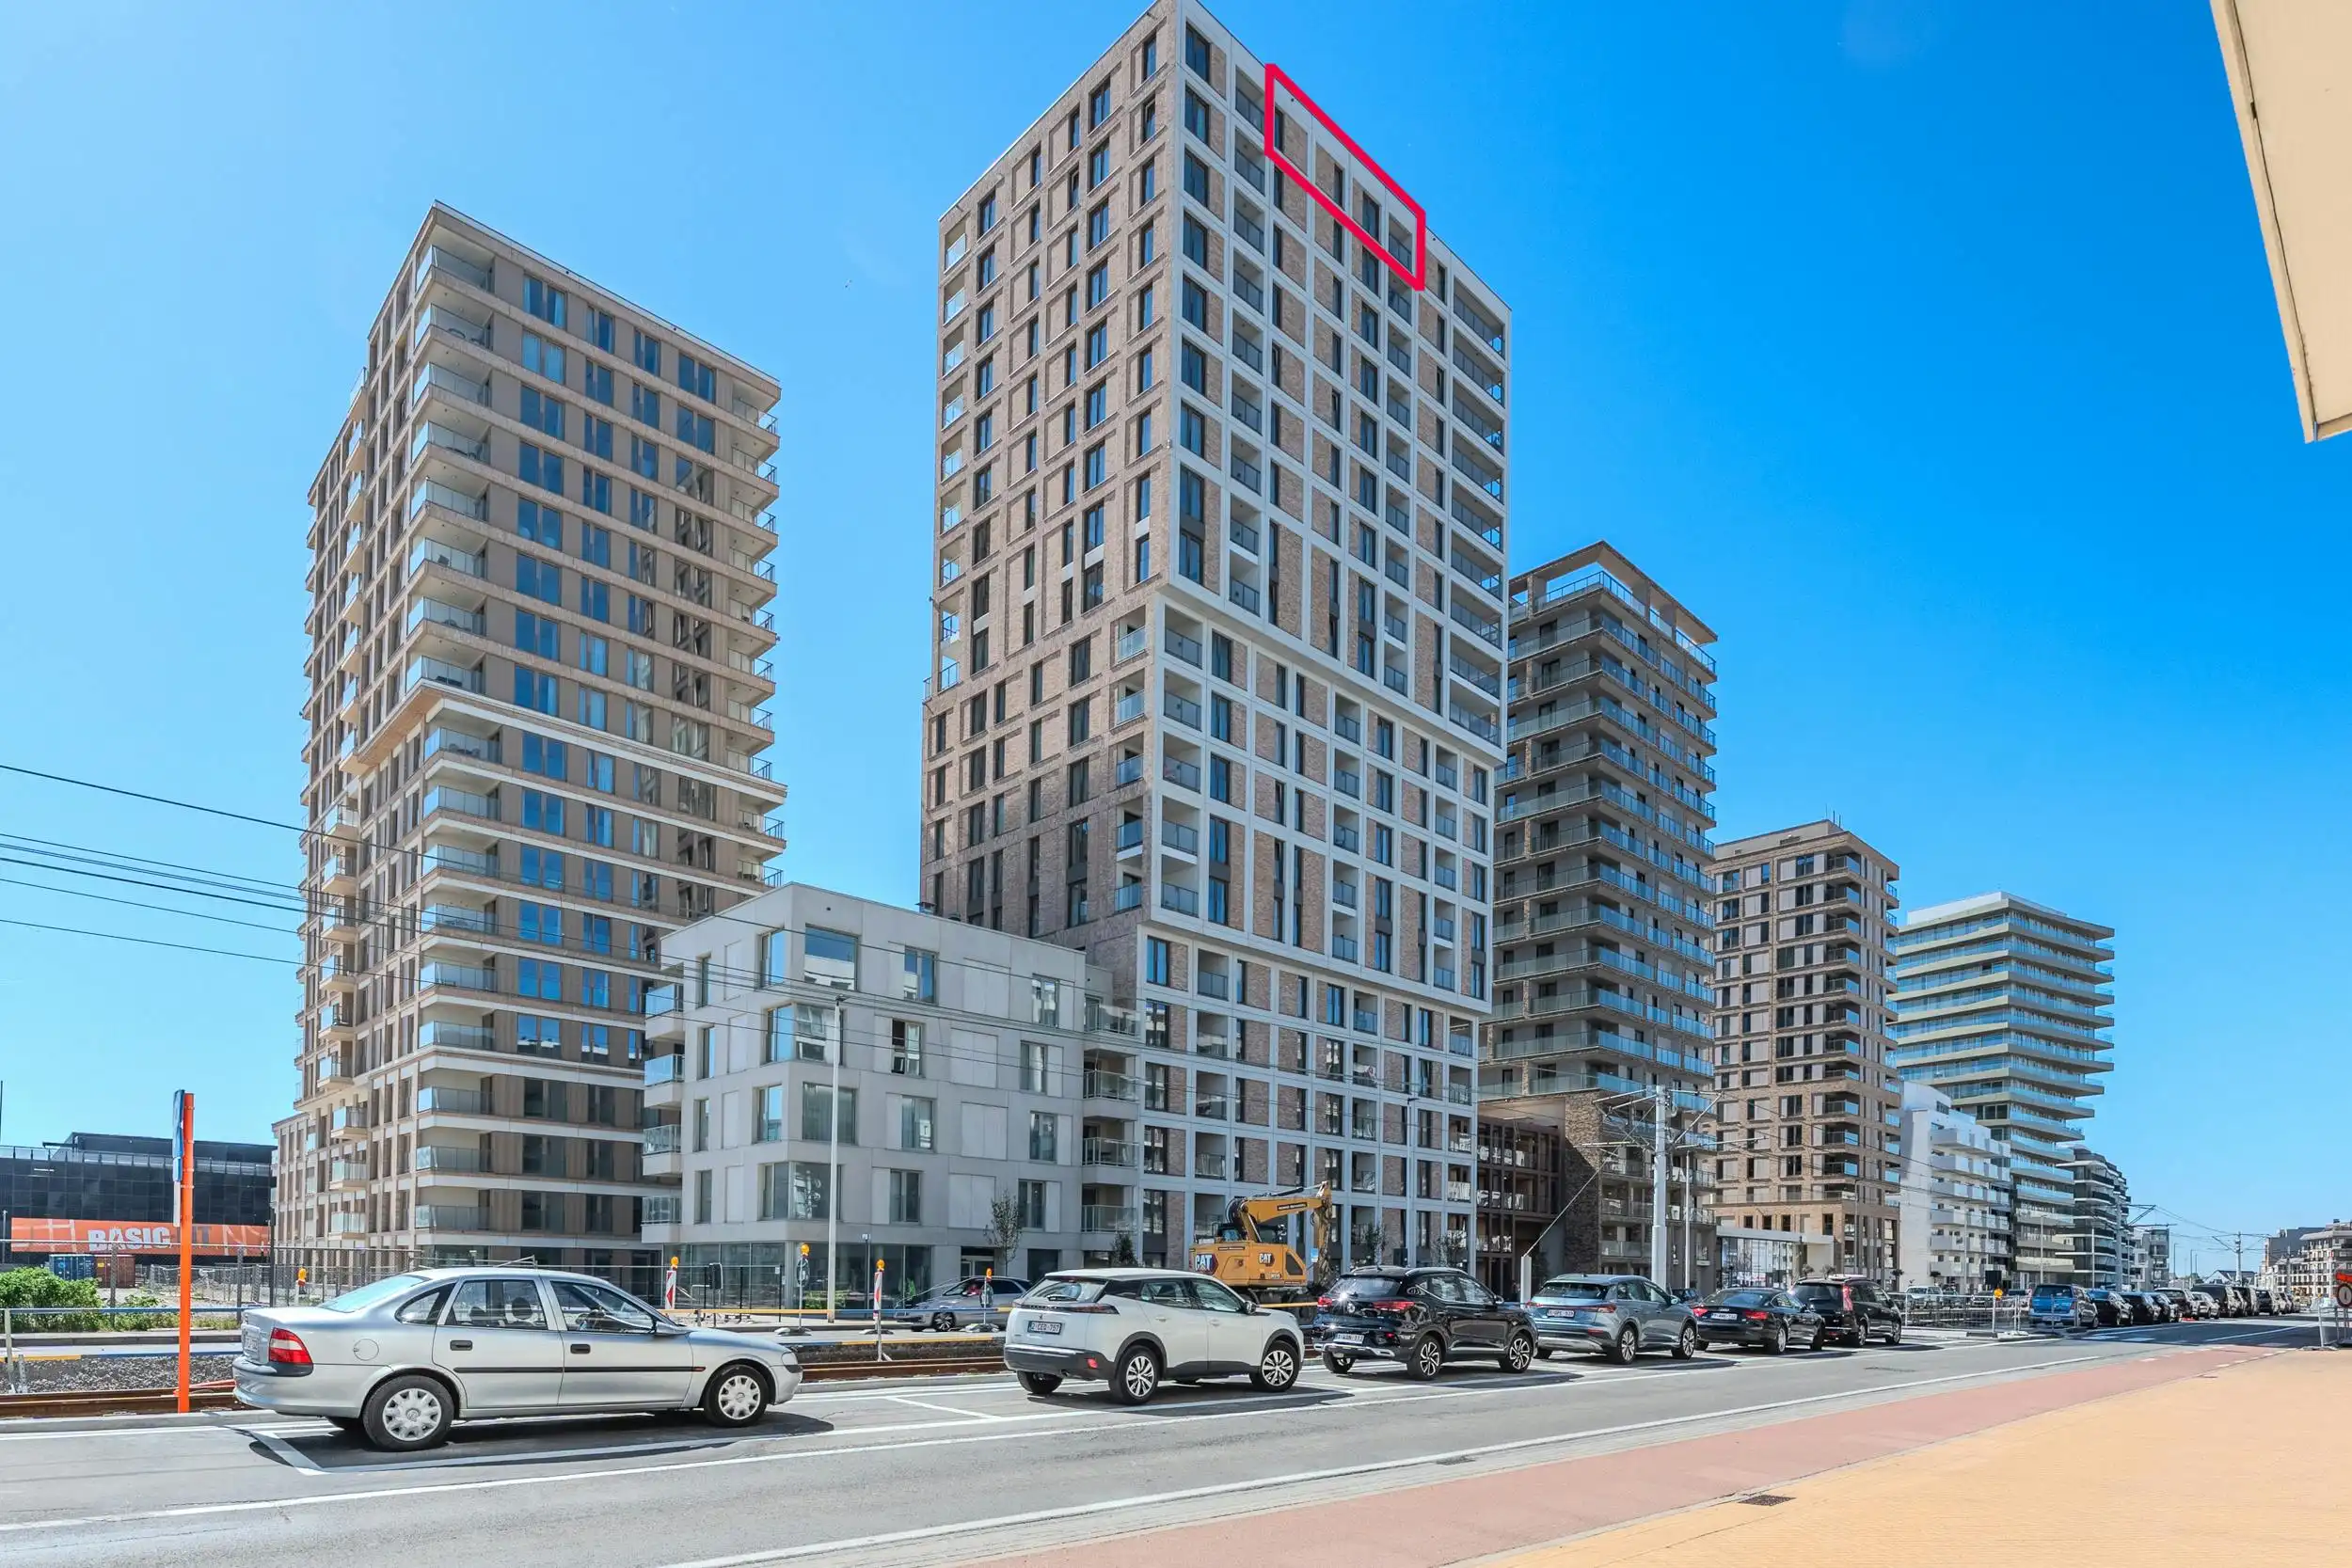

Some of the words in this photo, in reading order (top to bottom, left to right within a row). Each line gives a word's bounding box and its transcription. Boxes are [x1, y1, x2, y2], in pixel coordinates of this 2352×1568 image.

[87, 1227, 170, 1252] BASIC
[1195, 1254, 1213, 1272] CAT
[1259, 1253, 1272, 1264] CAT
